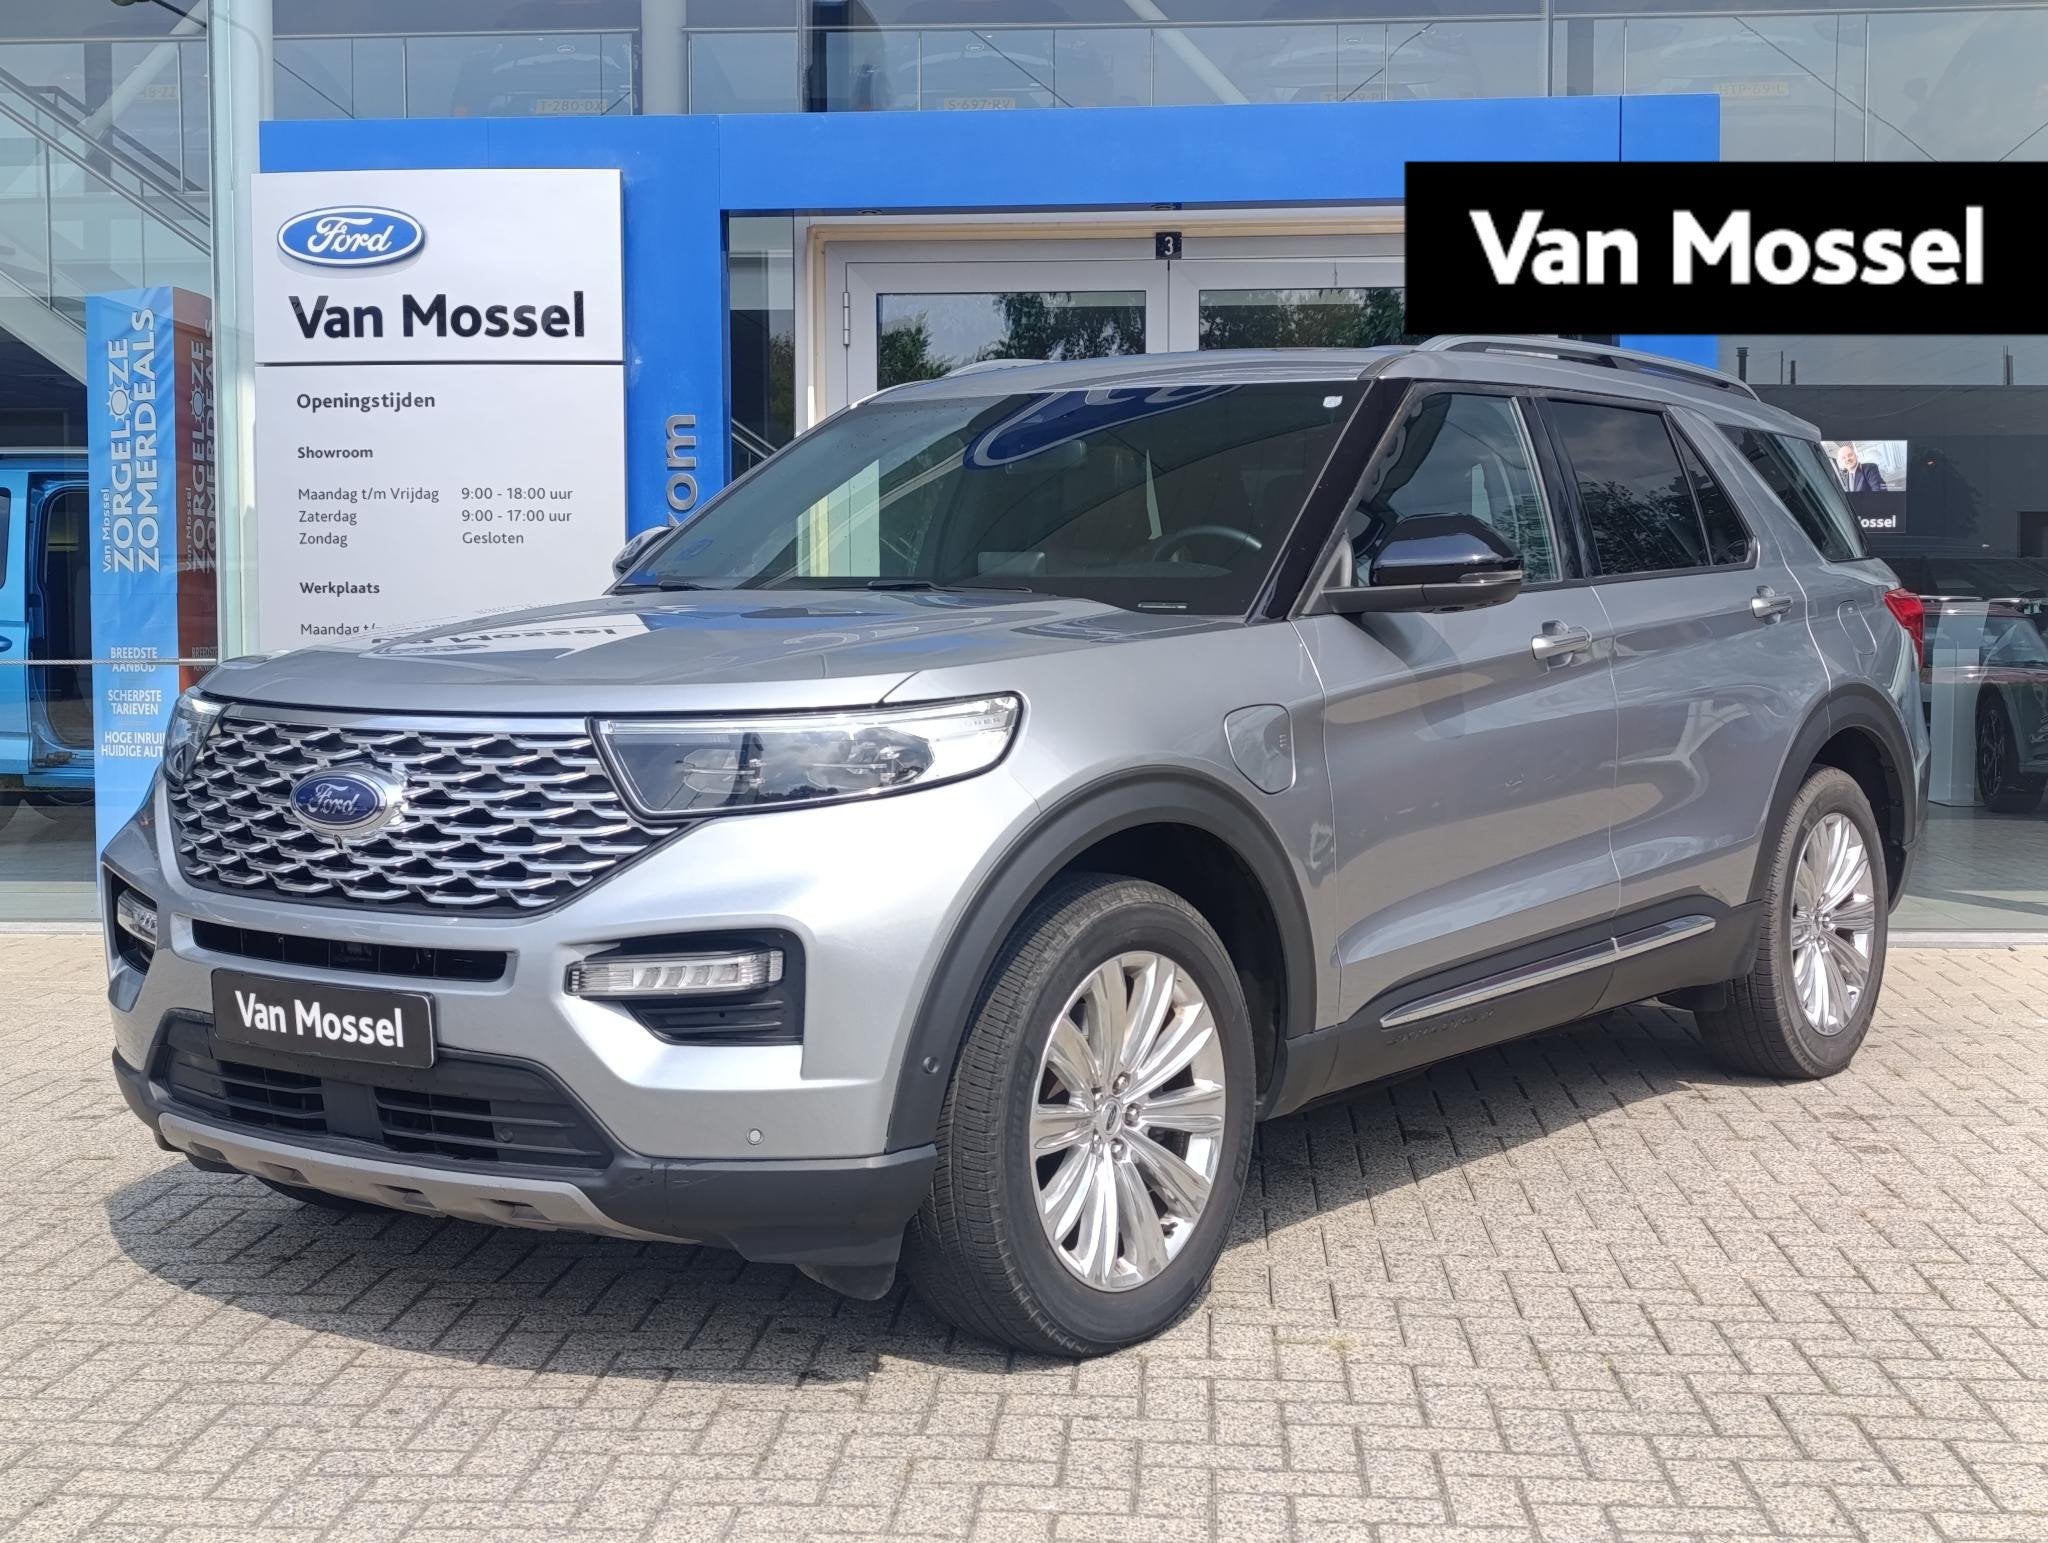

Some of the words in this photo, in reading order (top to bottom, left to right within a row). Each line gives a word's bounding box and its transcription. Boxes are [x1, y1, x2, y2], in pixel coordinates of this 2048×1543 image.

[307, 216, 394, 252] Ford
[1164, 236, 1174, 255] 3
[288, 295, 384, 339] Van
[402, 291, 586, 338] Mossel
[297, 391, 435, 414] Openingstijden
[131, 309, 160, 573] ZOMERDEALS
[297, 446, 373, 459] Showroom
[298, 487, 358, 505] Maandag
[361, 487, 386, 500] t/m
[390, 487, 440, 505] Vrijdag
[461, 487, 493, 501] 9:00
[506, 487, 546, 501] 18:00
[549, 490, 573, 501] uur
[101, 487, 112, 540] Mossel
[298, 509, 358, 526] Zaterdag
[461, 509, 493, 522] 9:00
[507, 509, 545, 522] 17:00
[548, 512, 572, 522] uur
[1857, 514, 1897, 528] ossel
[299, 531, 348, 549] Zondag
[462, 531, 524, 545] Gesloten
[102, 546, 113, 573] Van
[299, 580, 380, 597] Werkplaats
[110, 646, 158, 659] BREEDSTE
[107, 689, 162, 702] SCHERPSTE
[111, 702, 159, 715] TARIEVEN
[104, 731, 132, 744] HOGE
[100, 744, 142, 757] HUIDIGE
[307, 783, 360, 816] Ford
[234, 989, 287, 1034] Van
[293, 999, 404, 1048] Mossel
